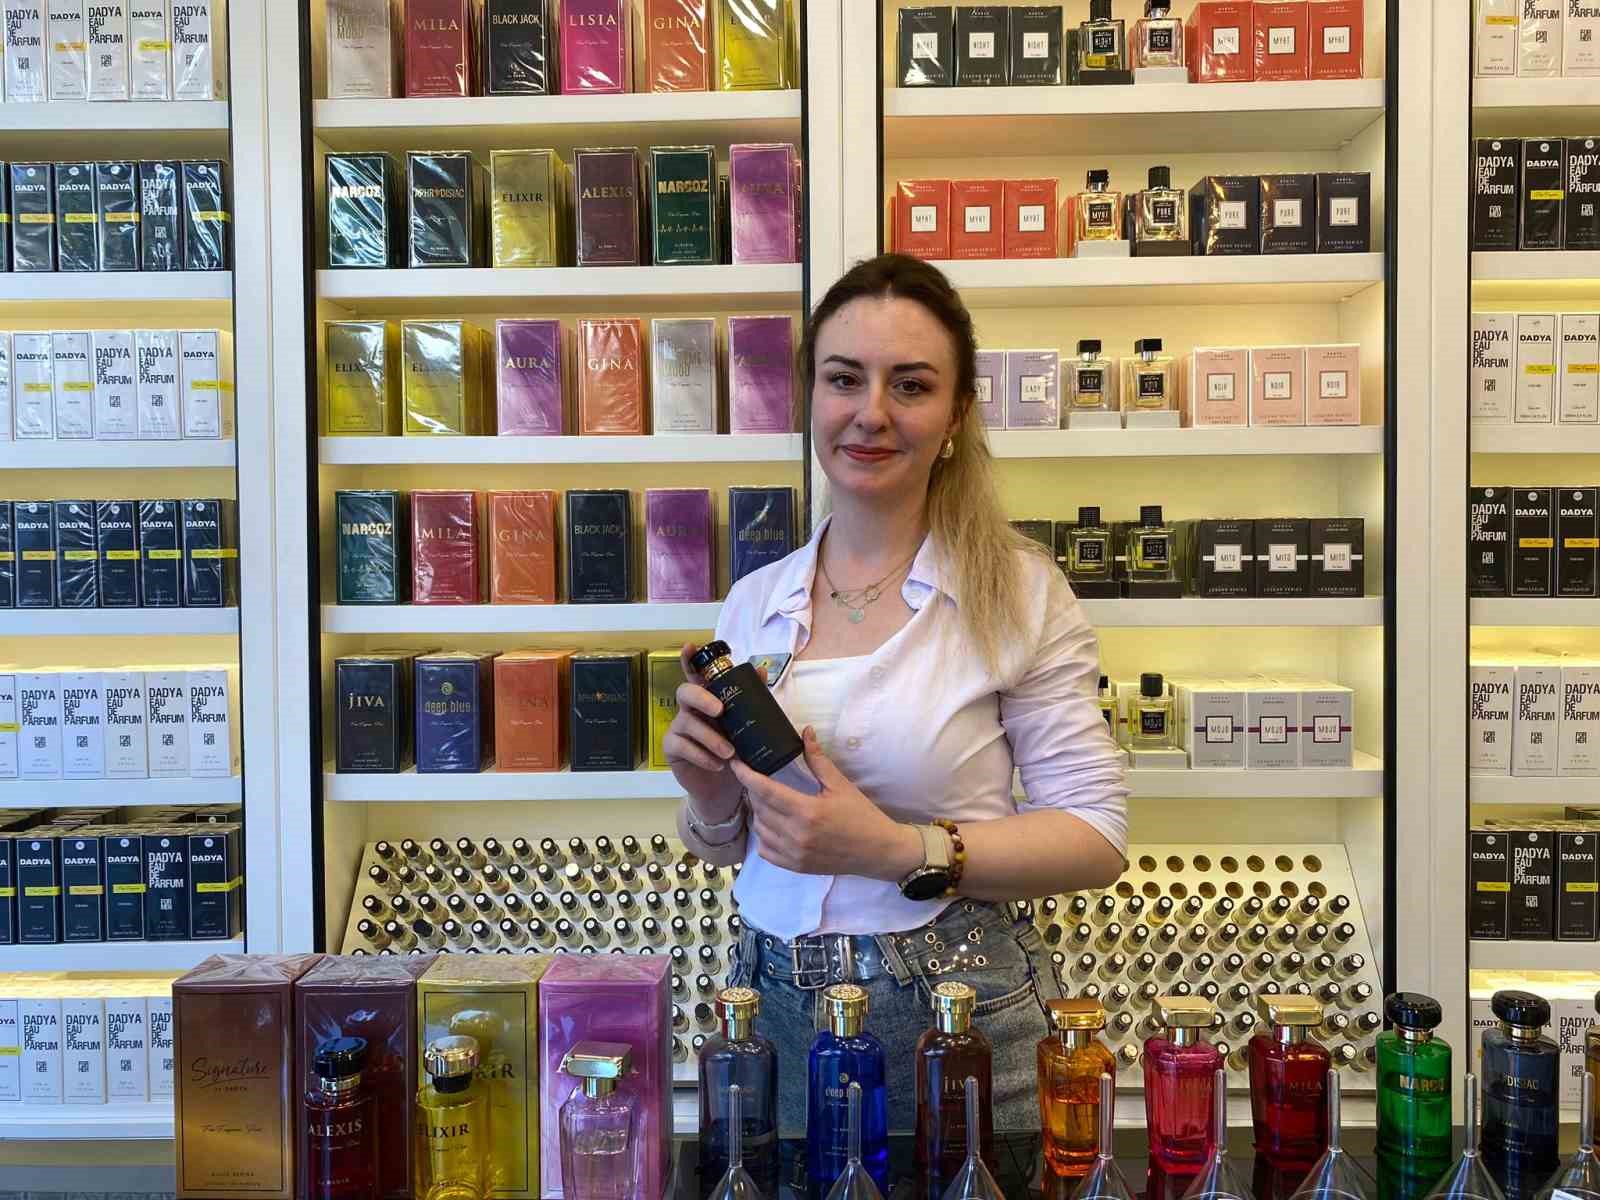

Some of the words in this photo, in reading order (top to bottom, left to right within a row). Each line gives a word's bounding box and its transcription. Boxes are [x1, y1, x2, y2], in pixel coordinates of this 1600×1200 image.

[6, 10, 39, 20] DADYA
[88, 7, 122, 17] DADYA
[174, 6, 206, 16] DADYA
[1524, 10, 1560, 19] PARFUM
[415, 18, 459, 31] MILA
[492, 14, 518, 25] BLACK
[520, 14, 540, 25] JACK
[570, 14, 617, 26] LISIA
[654, 16, 700, 30] GINA
[89, 26, 98, 34] DE
[7, 37, 40, 46] PARFUM
[89, 34, 122, 44] PARFUM
[174, 34, 208, 43] PARFUM
[1478, 157, 1514, 167] DADYA
[1478, 168, 1496, 176] EAU
[1570, 166, 1587, 175] EAU
[1478, 176, 1490, 184] DE
[1570, 176, 1581, 184] DE
[658, 179, 708, 194] NARCOZ
[1478, 184, 1514, 194] PARFUM
[1570, 184, 1600, 192] PARFU
[503, 192, 544, 202] ELIXIR
[582, 186, 633, 199] ALEXIS
[1474, 331, 1508, 340] DADYA
[1474, 342, 1490, 350] EAU
[96, 348, 130, 358] DADYA
[138, 348, 172, 358] DADYA
[505, 357, 550, 369] AURA
[588, 358, 634, 370] GINA
[1473, 358, 1508, 368] PARFUM
[140, 367, 150, 375] DE
[97, 376, 132, 384] PARFUM
[140, 374, 174, 384] PARFUM
[1472, 504, 1506, 514] DADYA
[1472, 515, 1488, 524] EAU
[342, 522, 392, 536] NARCOZ
[1472, 524, 1482, 532] DE
[422, 528, 466, 539] MILA
[499, 528, 545, 542] GINA
[739, 528, 762, 543] deep
[764, 527, 784, 540] blue
[1472, 532, 1506, 541] PARFUM
[150, 688, 183, 698] DADYA
[191, 687, 224, 697] DADYA
[1472, 683, 1508, 694] DADYA
[1520, 684, 1555, 694] DADYA
[1565, 684, 1600, 694] DADYA
[22, 690, 56, 700] DADYA
[64, 690, 98, 699] DADYA
[106, 689, 140, 699] DADYA
[1472, 694, 1490, 702] EAU
[1520, 694, 1537, 703] EAU
[1565, 694, 1582, 703] EAU
[425, 700, 448, 714] deep
[450, 700, 471, 713] blue
[1472, 703, 1484, 711] DE
[1520, 704, 1531, 712] DE
[1565, 704, 1576, 712] DE
[64, 716, 99, 724] PARFUM
[108, 715, 142, 724] PARFUM
[150, 714, 184, 724] PARFUM
[192, 714, 226, 722] PARFUM
[1472, 711, 1508, 720] PARFUM
[1520, 712, 1555, 720] PARFUM
[1564, 712, 1600, 720] PARFUM
[22, 716, 57, 726] PARFUM
[149, 853, 182, 862] DADYA
[1514, 848, 1550, 858] DADYA
[1515, 858, 1532, 867] EAU
[150, 878, 184, 888] PARFUM
[1514, 874, 1550, 884] PARFUM
[24, 1015, 56, 1025] DADYA
[66, 1015, 99, 1024] DADYA
[109, 1014, 142, 1024] DADYA
[151, 1013, 172, 1022] DAD
[1560, 1017, 1596, 1028] DADYA
[24, 1025, 40, 1033] EAU
[66, 1025, 82, 1033] EAU
[109, 1024, 124, 1032] EAU
[152, 1023, 167, 1031] EAU
[1560, 1028, 1578, 1036] EAU
[24, 1042, 58, 1050] PARFUM
[66, 1042, 100, 1050] PARFUM
[109, 1040, 142, 1048] PARFUM
[152, 1040, 172, 1048] PARF
[1560, 1044, 1585, 1054] PARF
[191, 1056, 268, 1082] Signature
[308, 1118, 362, 1137] ALEXIS
